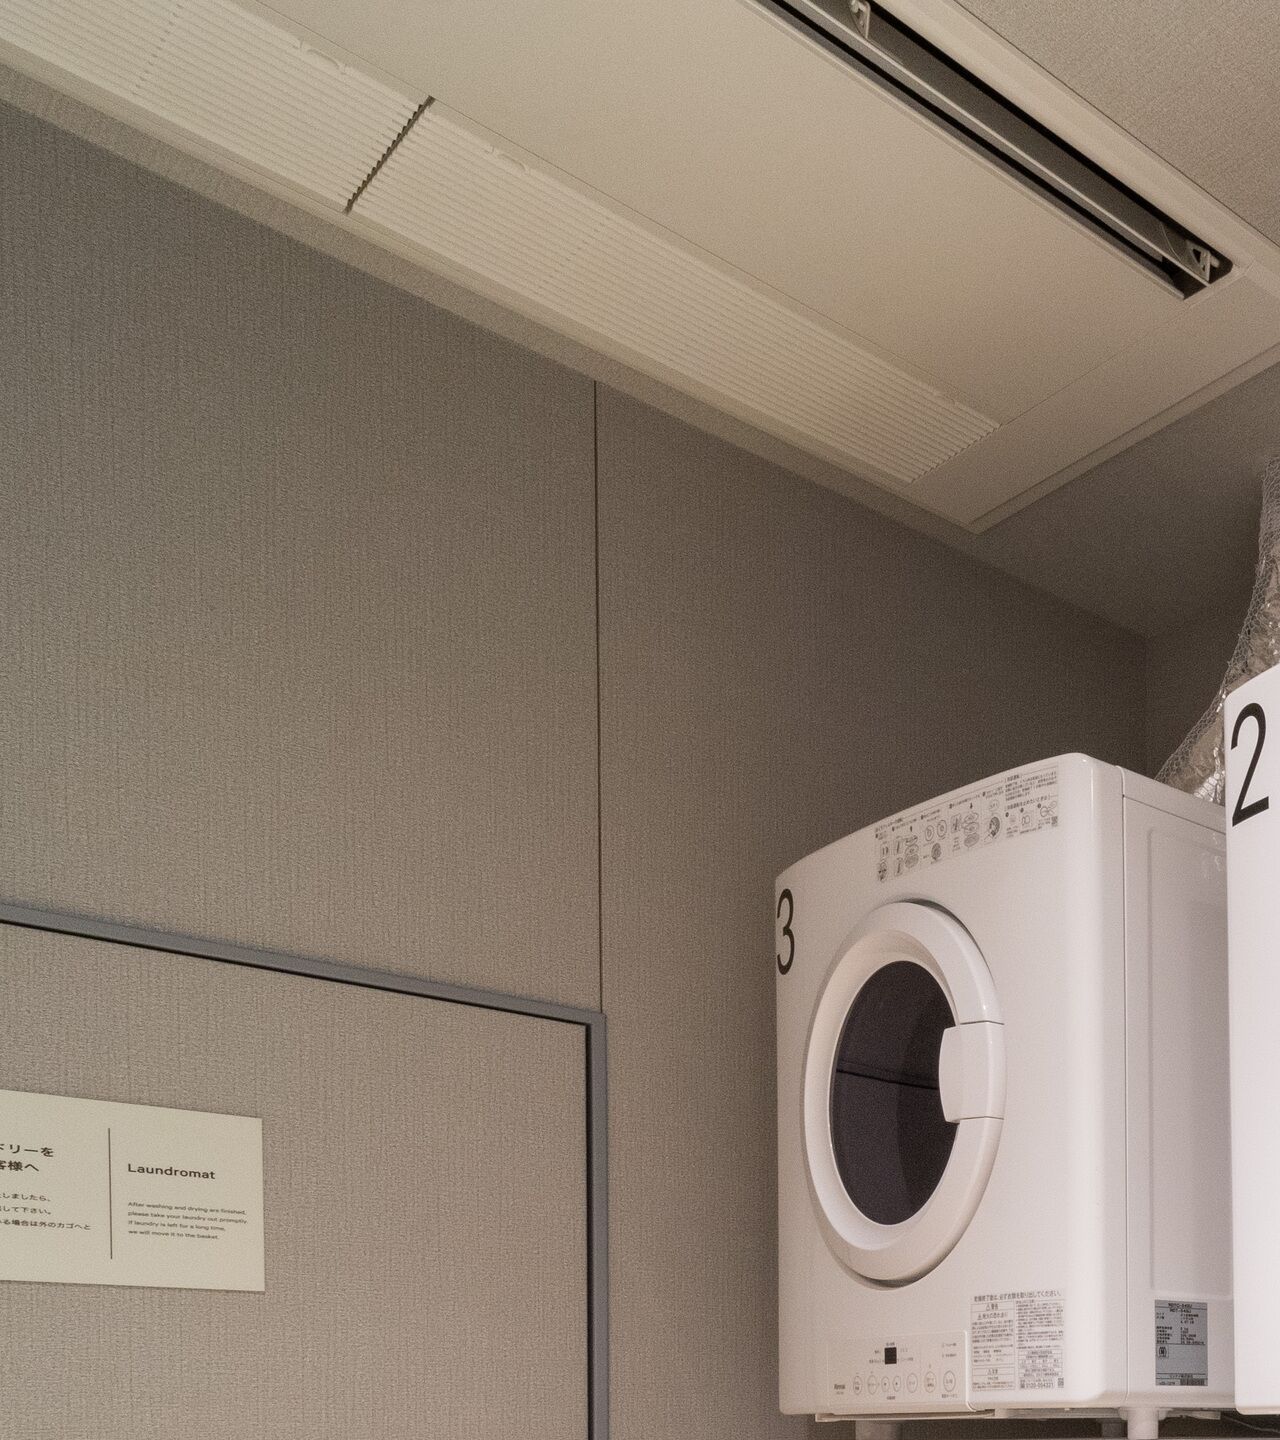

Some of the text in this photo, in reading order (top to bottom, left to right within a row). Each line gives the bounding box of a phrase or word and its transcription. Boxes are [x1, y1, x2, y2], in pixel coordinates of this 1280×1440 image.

[1231, 702, 1269, 827] 2
[777, 888, 795, 975] 3
[128, 1163, 216, 1180] Laundromat
[0, 1192, 51, 1202] しましたら、
[0, 1205, 51, 1215] して下さい。
[0, 1219, 91, 1231] る場合は外のカゴへと
